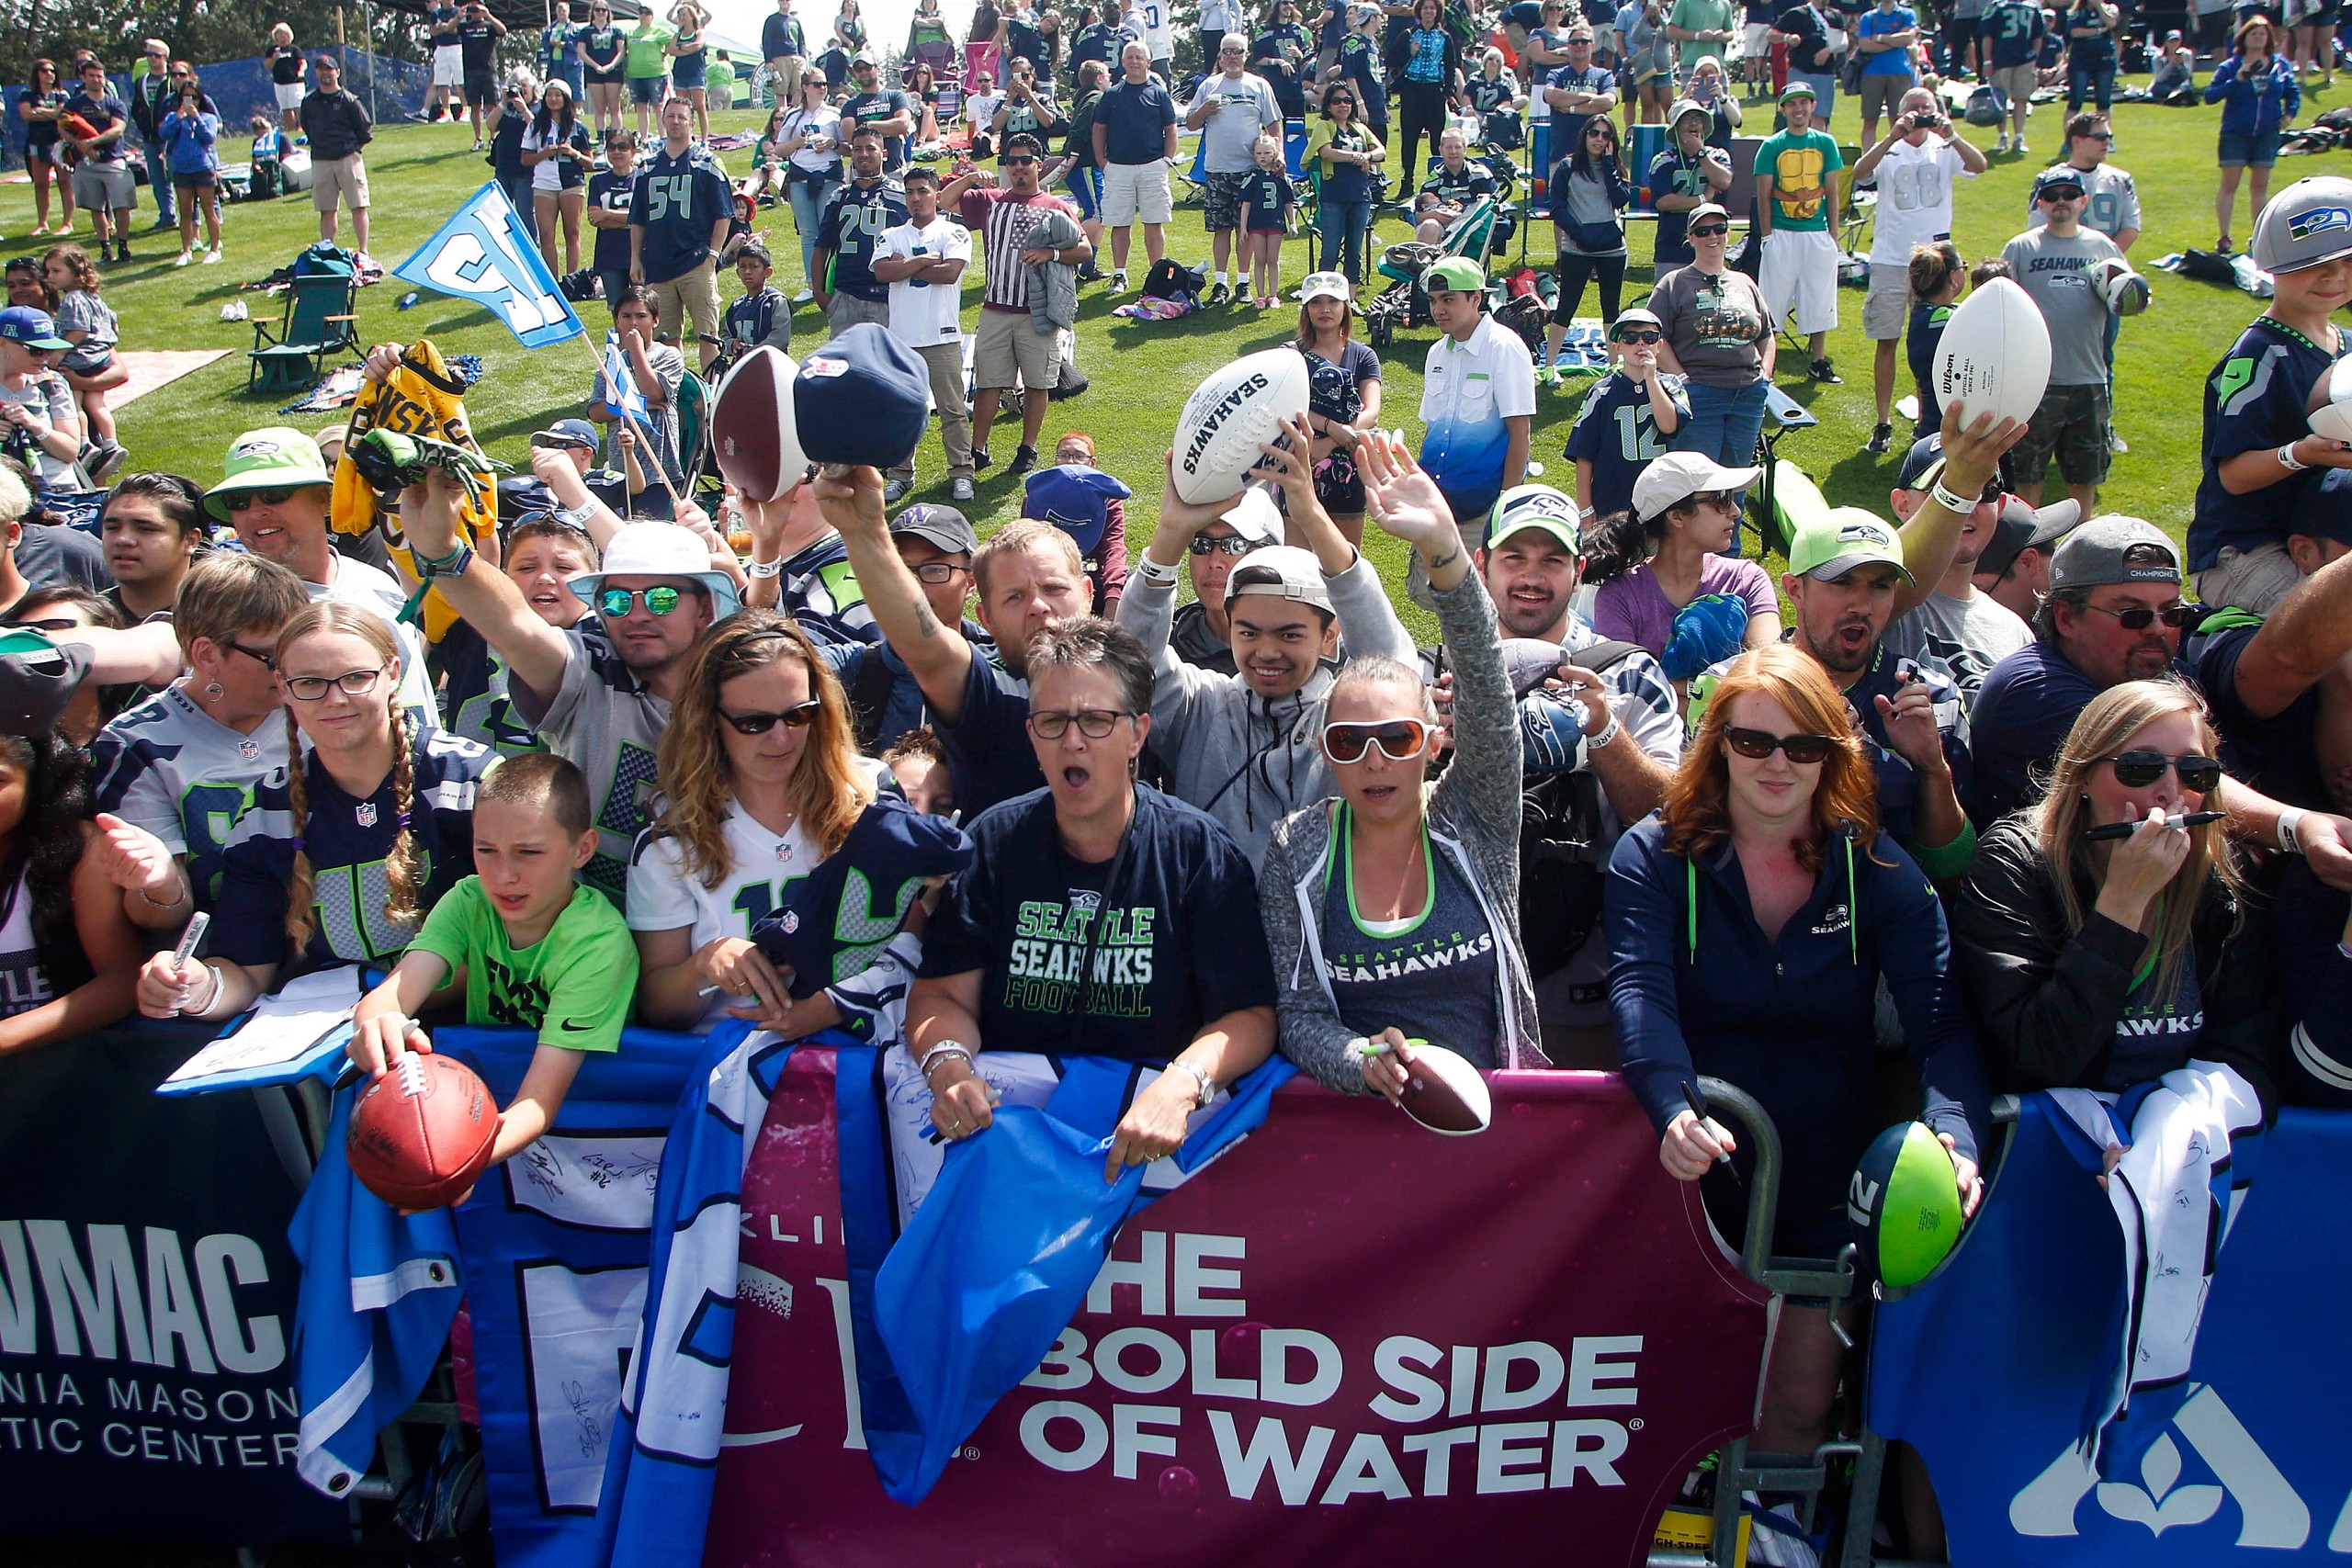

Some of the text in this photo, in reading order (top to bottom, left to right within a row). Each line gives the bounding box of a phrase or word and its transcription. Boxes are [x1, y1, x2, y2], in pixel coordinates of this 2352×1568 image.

[2001, 8, 2034, 39] 34
[1476, 86, 1498, 110] 12
[649, 174, 693, 221] 54
[1261, 182, 1278, 209] 3
[839, 204, 887, 254] 24
[1943, 353, 1955, 394] Wilson
[1182, 371, 1269, 477] SEAHAWKS
[1613, 402, 1667, 461] 12
[902, 505, 938, 525] W
[2129, 569, 2174, 578] CHAMPIONS
[1325, 931, 1494, 983] SEAHAWKS
[1339, 931, 1464, 964] SEATTLE
[1087, 1229, 1247, 1316] HE
[1019, 1326, 1644, 1422] BOLD SIDE
[107, 1377, 300, 1423] MASON
[102, 1422, 300, 1466] CENTER
[1019, 1400, 1182, 1480] OF
